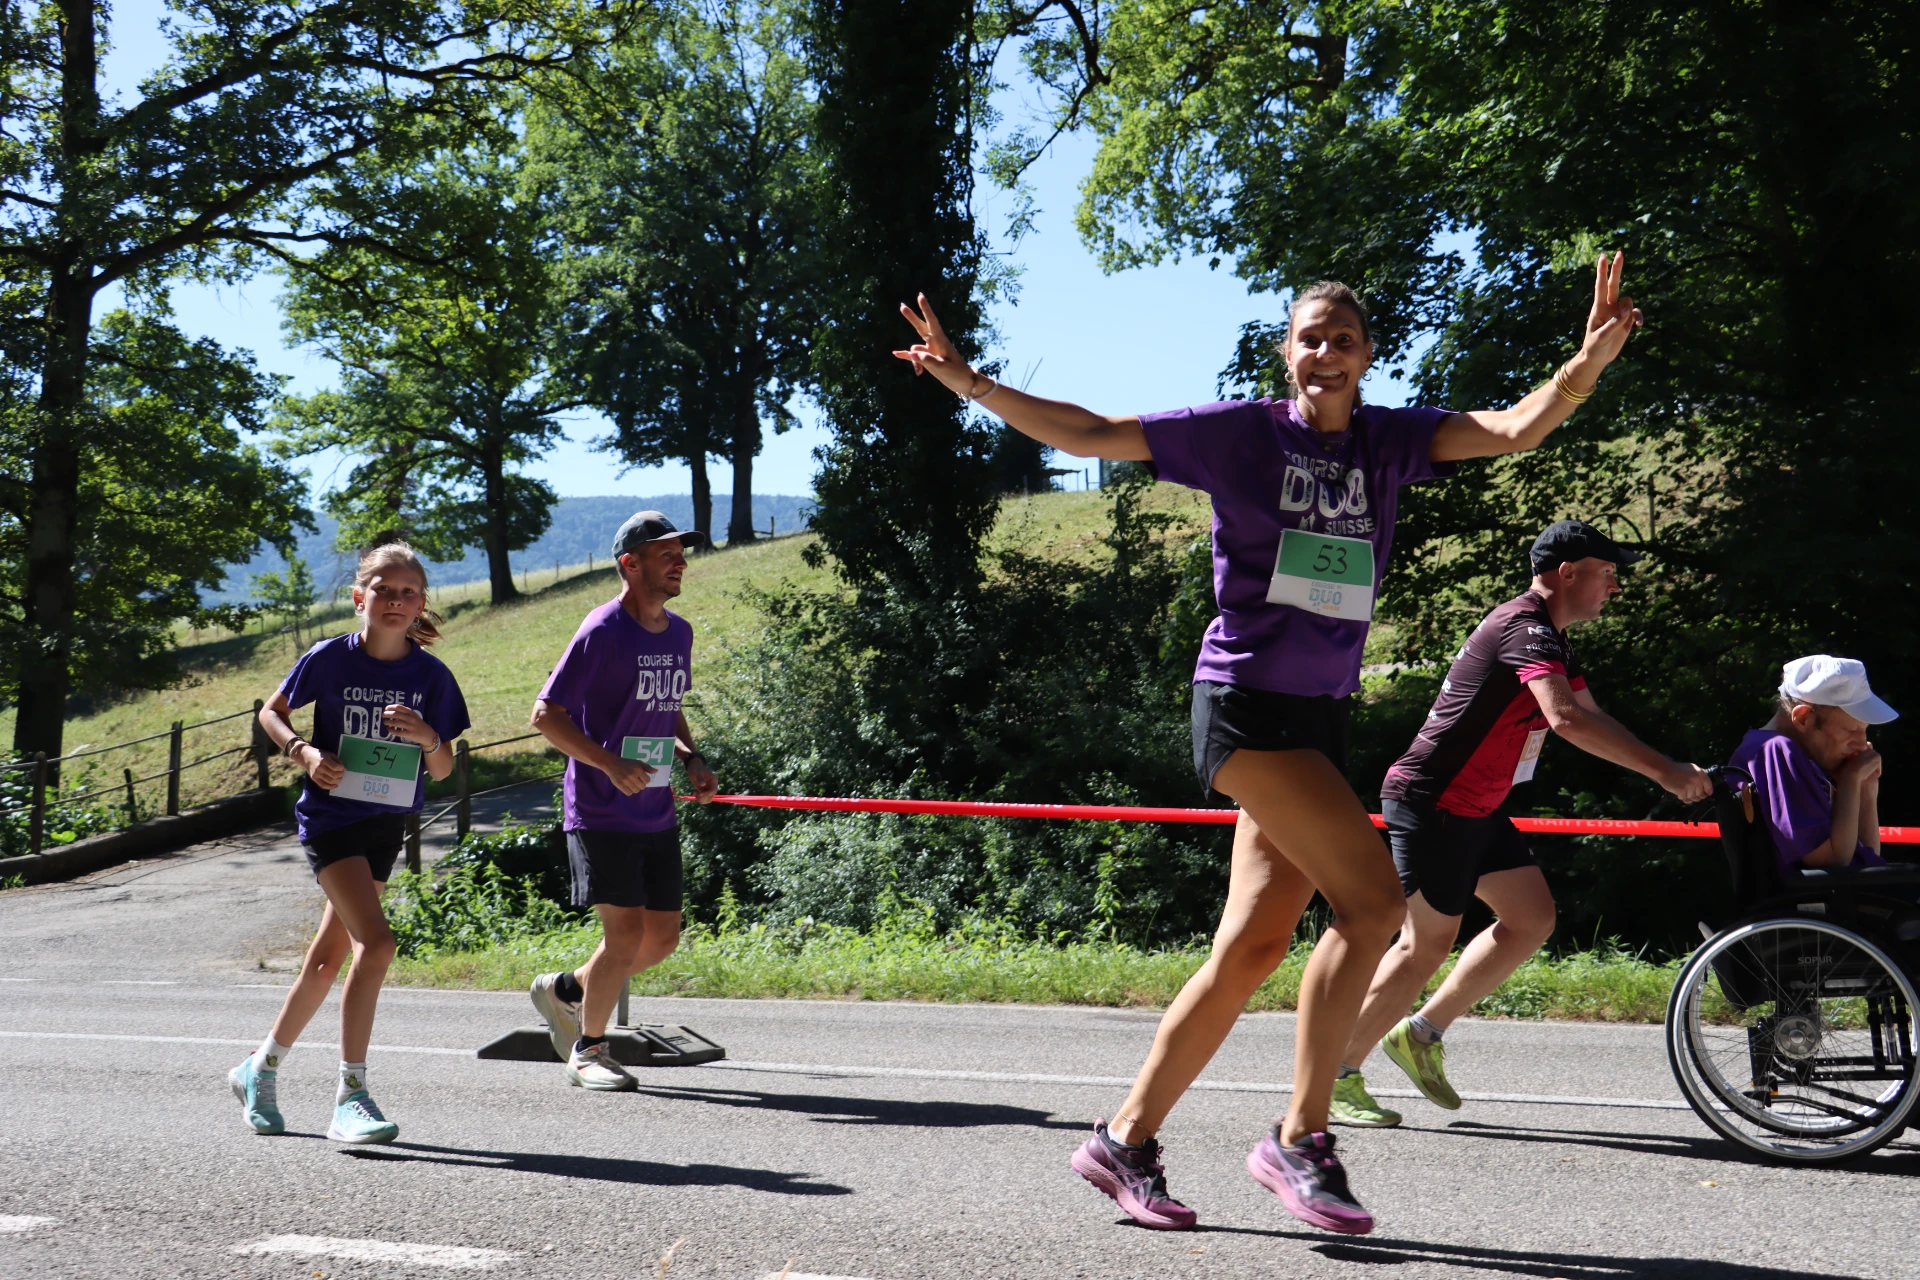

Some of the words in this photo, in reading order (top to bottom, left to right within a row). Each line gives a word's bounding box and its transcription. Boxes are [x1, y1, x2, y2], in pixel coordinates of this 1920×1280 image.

[1279, 465, 1368, 518] DUO
[1324, 517, 1375, 536] SUISSE
[1312, 544, 1348, 575] 53
[1308, 588, 1342, 606] DUO
[637, 654, 673, 667] COURSE
[636, 669, 687, 700] DUO
[343, 686, 405, 705] COURSE
[343, 704, 424, 746] DU
[366, 745, 398, 769] 54
[636, 740, 665, 763] 54
[362, 780, 390, 795] DUO
[1797, 955, 1833, 965] SOPUR
